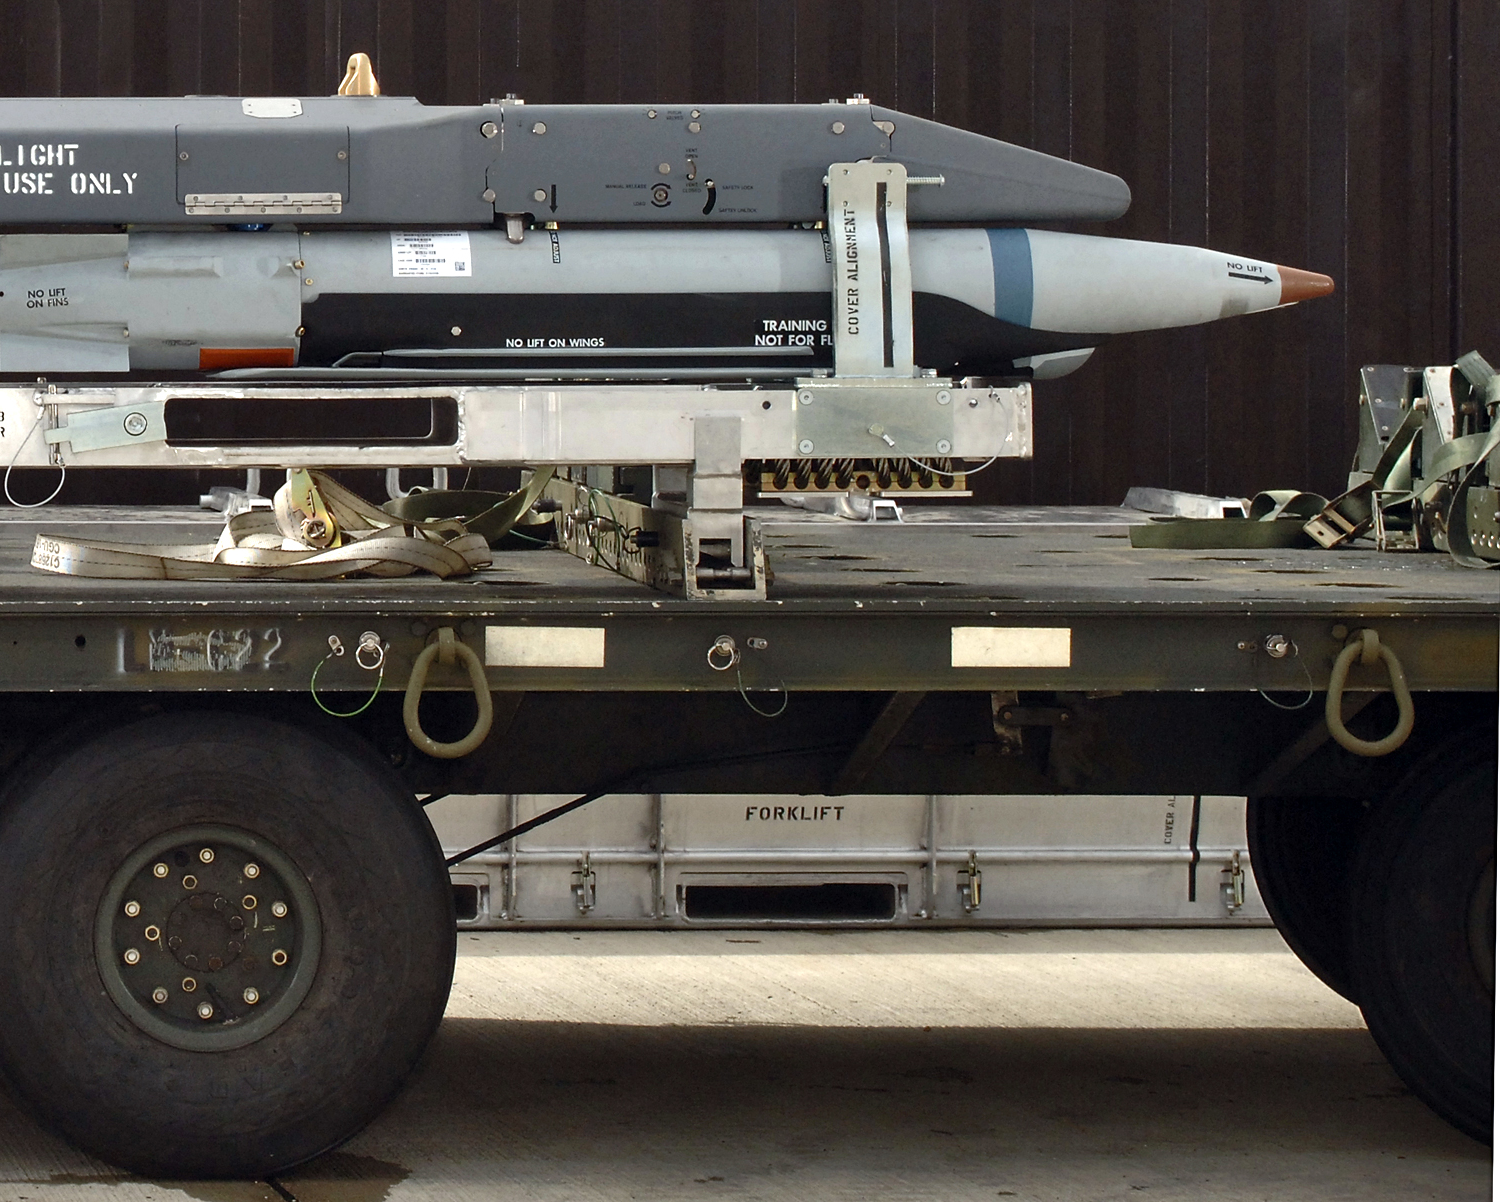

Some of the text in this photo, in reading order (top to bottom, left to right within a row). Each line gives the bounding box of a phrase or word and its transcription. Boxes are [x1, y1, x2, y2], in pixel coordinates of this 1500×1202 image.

[3, 172, 53, 195] USE
[70, 172, 138, 195] ONLY
[844, 208, 859, 336] COVER ALIGNMENT
[1227, 261, 1263, 273] NO LIFT
[27, 288, 66, 299] NO LIFT
[26, 297, 69, 309] ON FINS
[763, 319, 827, 332] TRAINING
[506, 337, 605, 348] NO LIFT ON WINGS
[754, 334, 834, 346] NOT FOR FL
[745, 806, 845, 821] FORKLIFT
[1164, 796, 1176, 845] COVER AL
